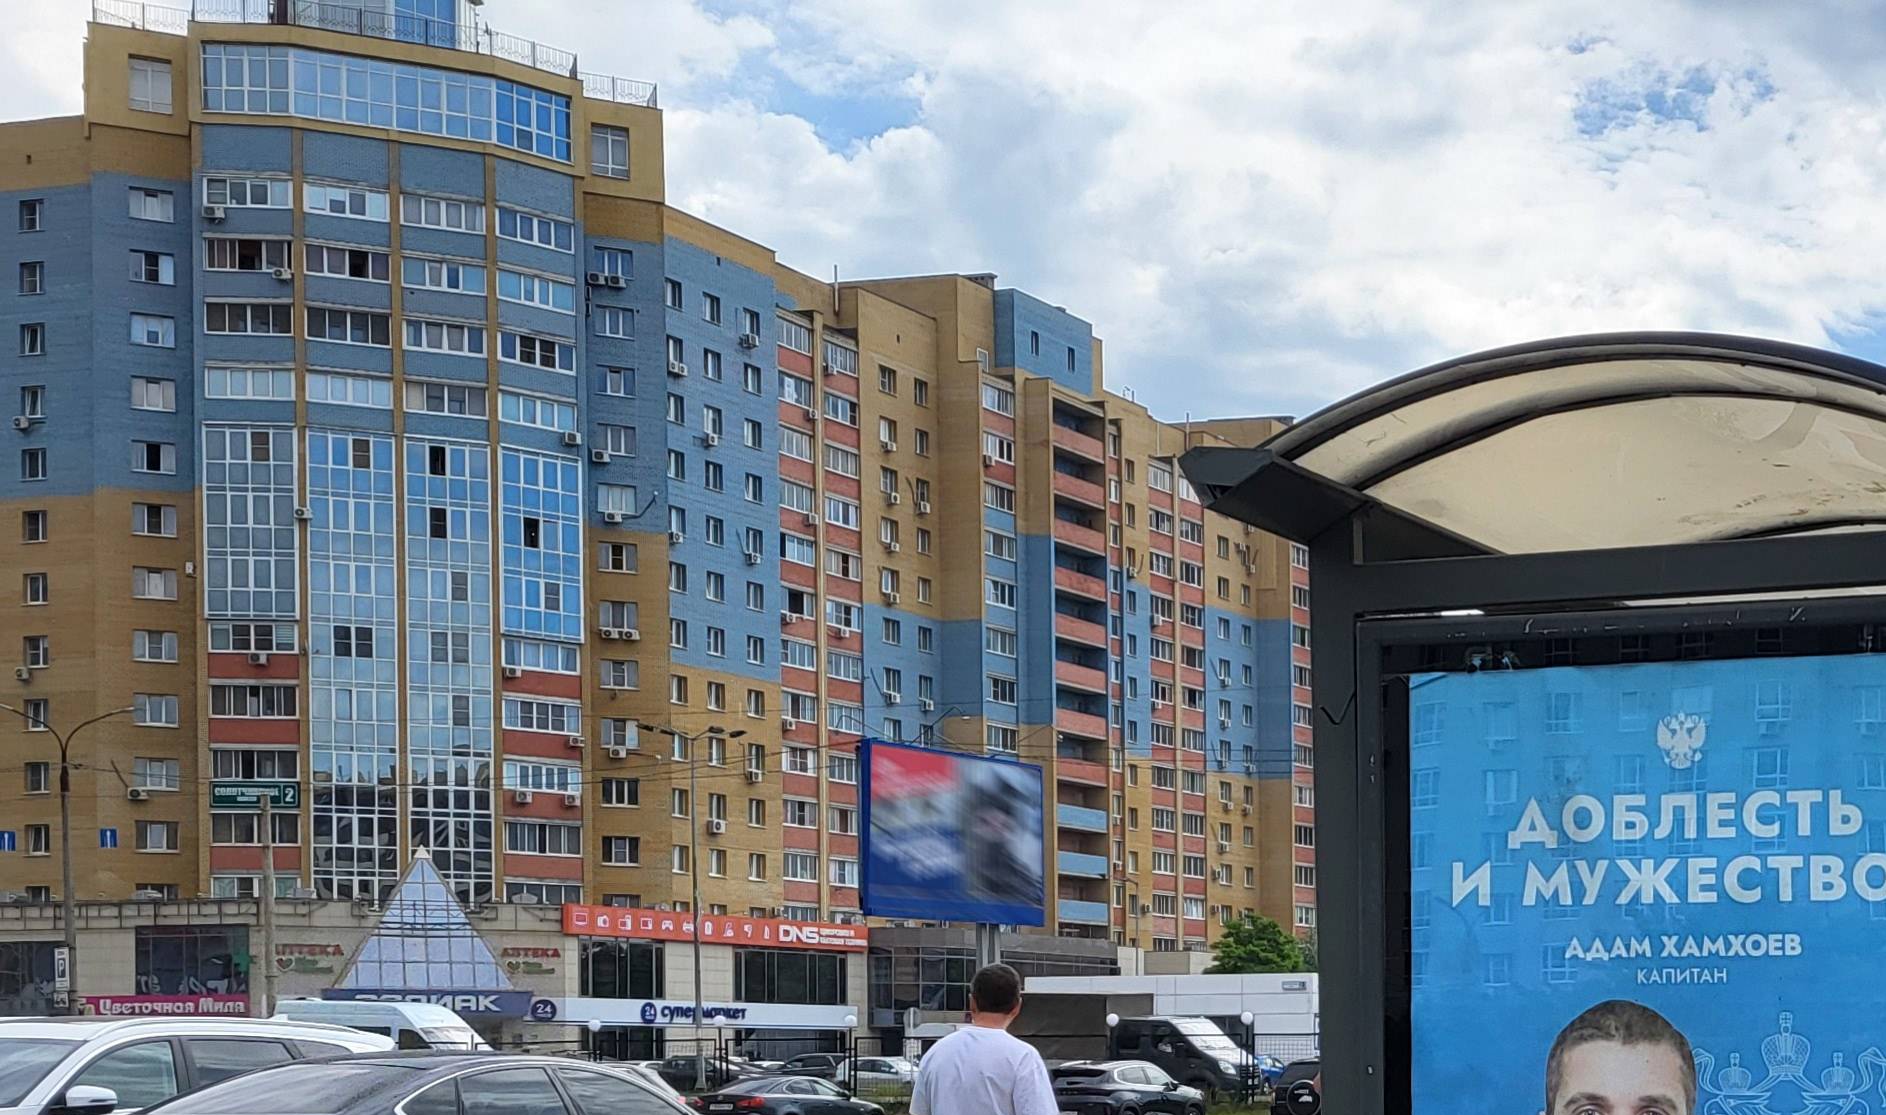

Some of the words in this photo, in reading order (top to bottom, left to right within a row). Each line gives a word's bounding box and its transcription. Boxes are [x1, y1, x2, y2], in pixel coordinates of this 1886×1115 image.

[284, 787, 294, 802] 2
[1507, 789, 1863, 850] ДОБЛЕСТЬ
[1451, 860, 1492, 907] И
[778, 924, 819, 944] DNS
[1564, 934, 1652, 961] АДАМ
[1660, 932, 1803, 958] ХАМХОЕВ
[1636, 967, 1728, 985] КАПИТАН
[99, 999, 194, 1016] Цветочная
[198, 997, 246, 1013] Мила
[536, 1003, 552, 1013] 24
